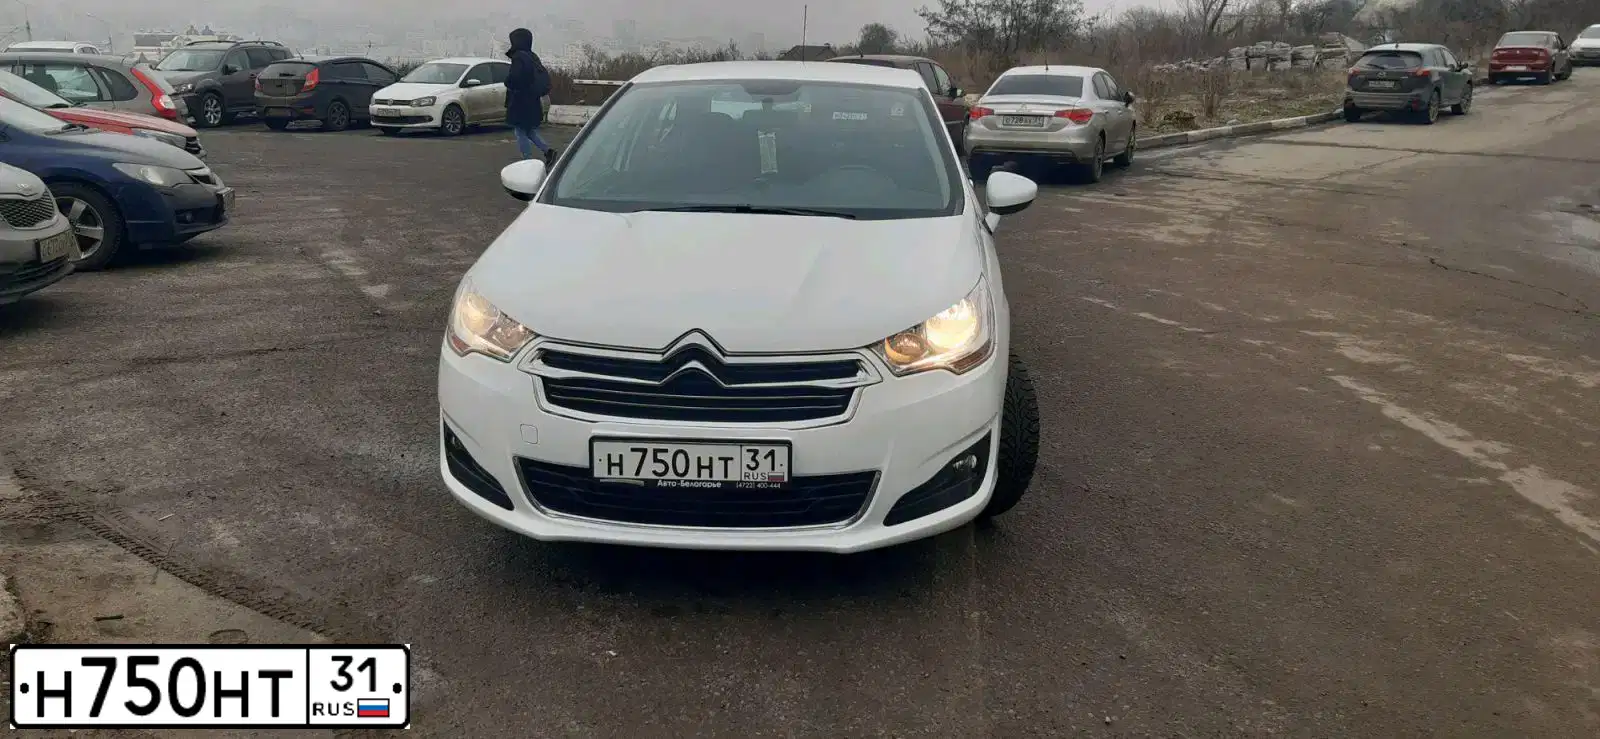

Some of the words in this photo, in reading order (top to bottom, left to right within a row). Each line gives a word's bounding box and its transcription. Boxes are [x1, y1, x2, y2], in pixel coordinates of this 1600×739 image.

[606, 447, 734, 478] Н750НТ
[746, 448, 776, 471] 31
[743, 471, 767, 480] RUS
